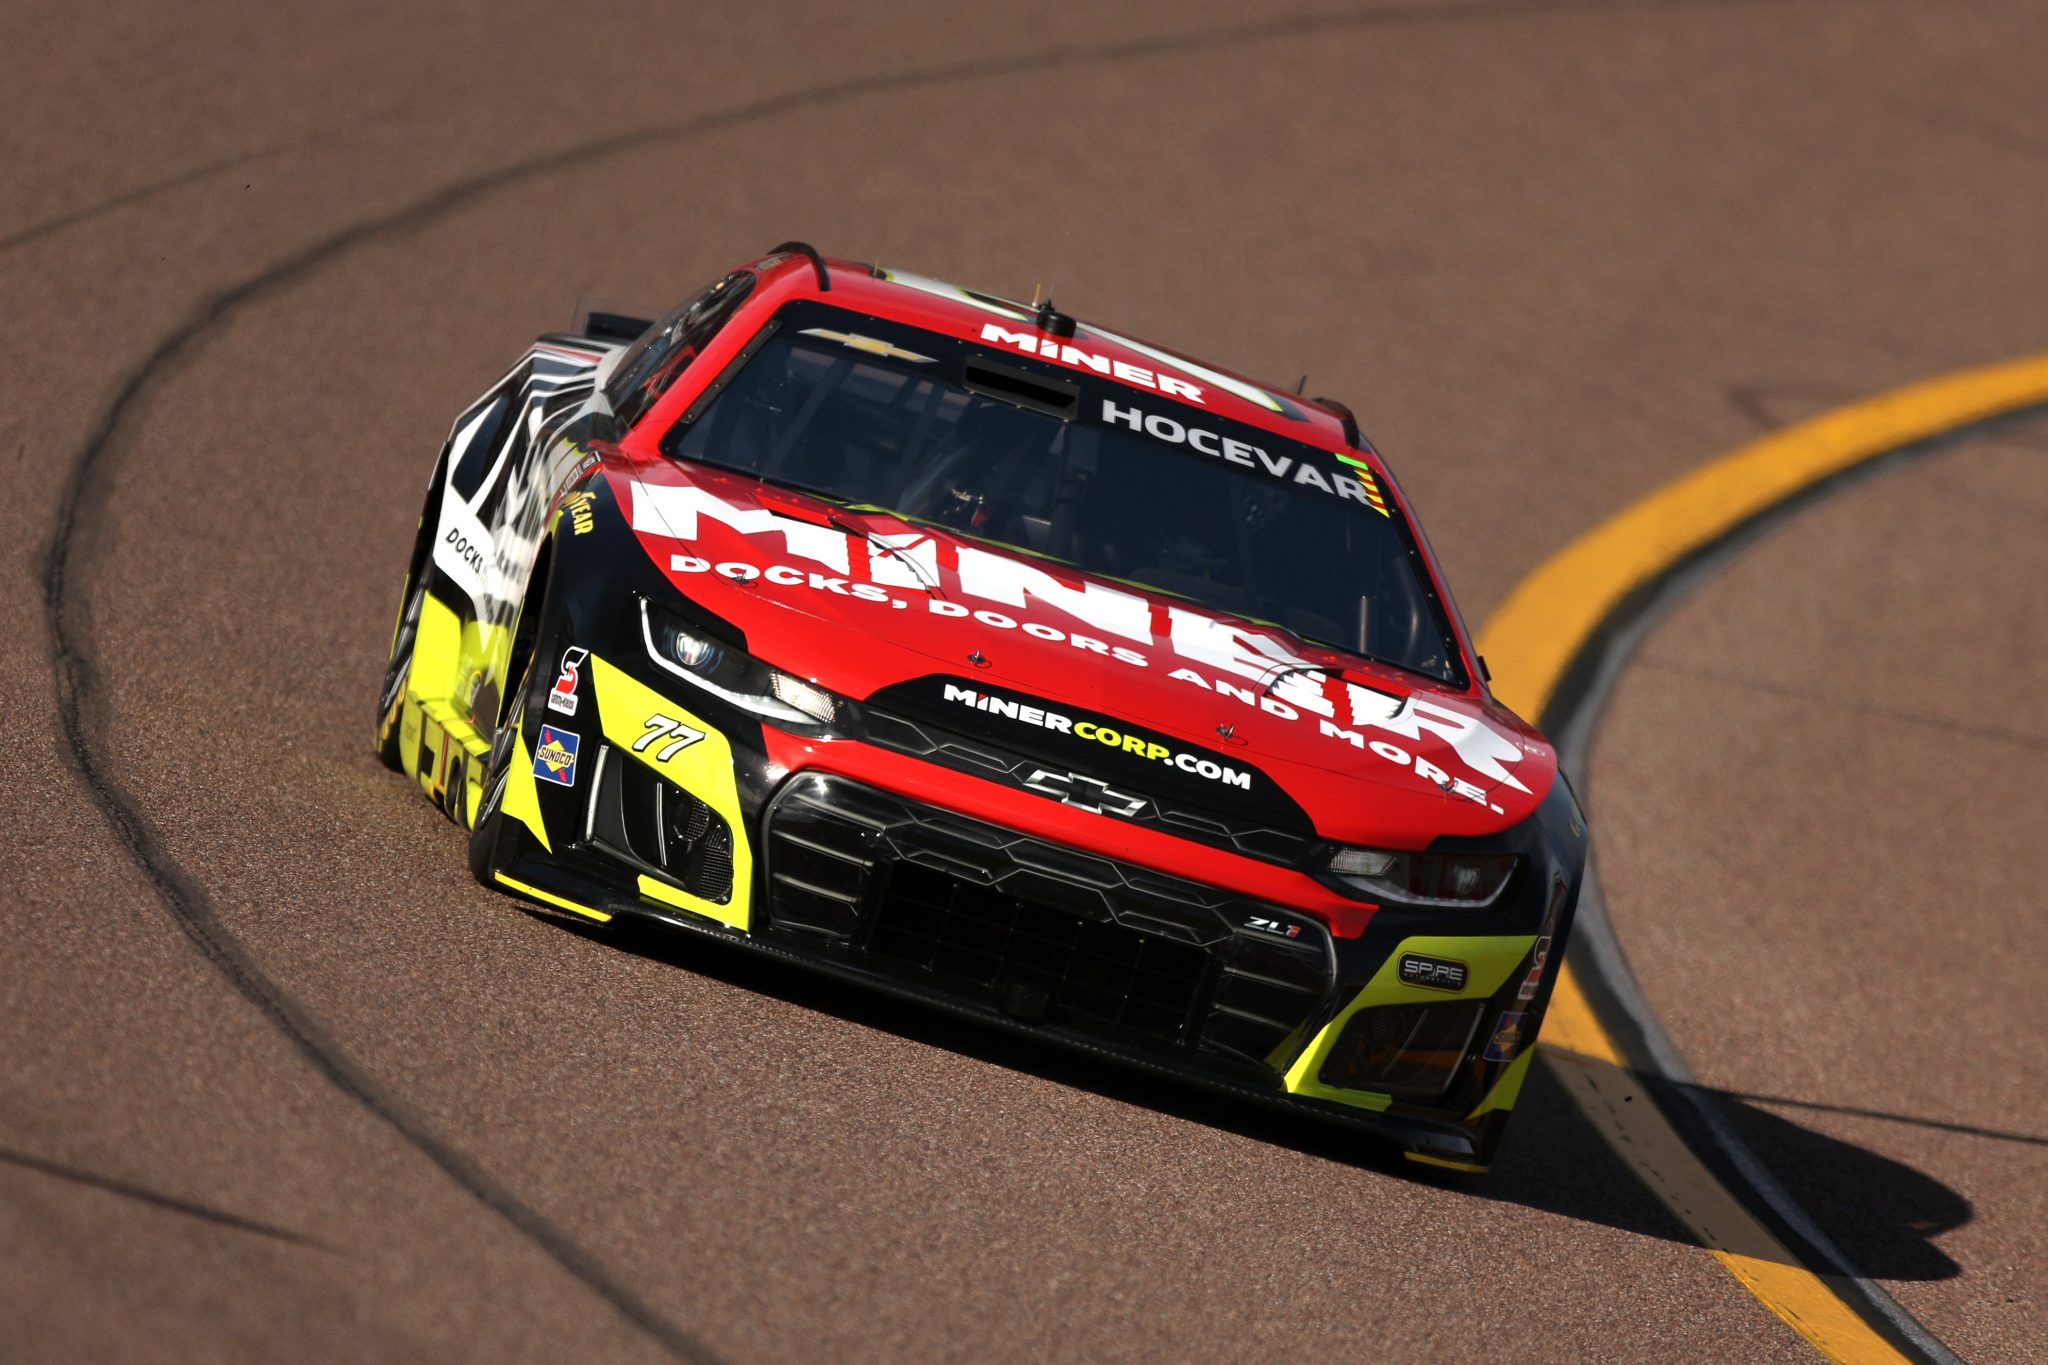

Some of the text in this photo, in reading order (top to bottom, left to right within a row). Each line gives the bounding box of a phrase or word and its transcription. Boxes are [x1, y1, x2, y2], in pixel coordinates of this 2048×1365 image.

[1102, 400, 1370, 506] HOCEVAR
[670, 554, 1504, 815] DOCKS, DOORS AND MORE.
[539, 746, 571, 766] SUNOCO
[632, 713, 706, 763] 77
[1243, 916, 1301, 938] ZL1
